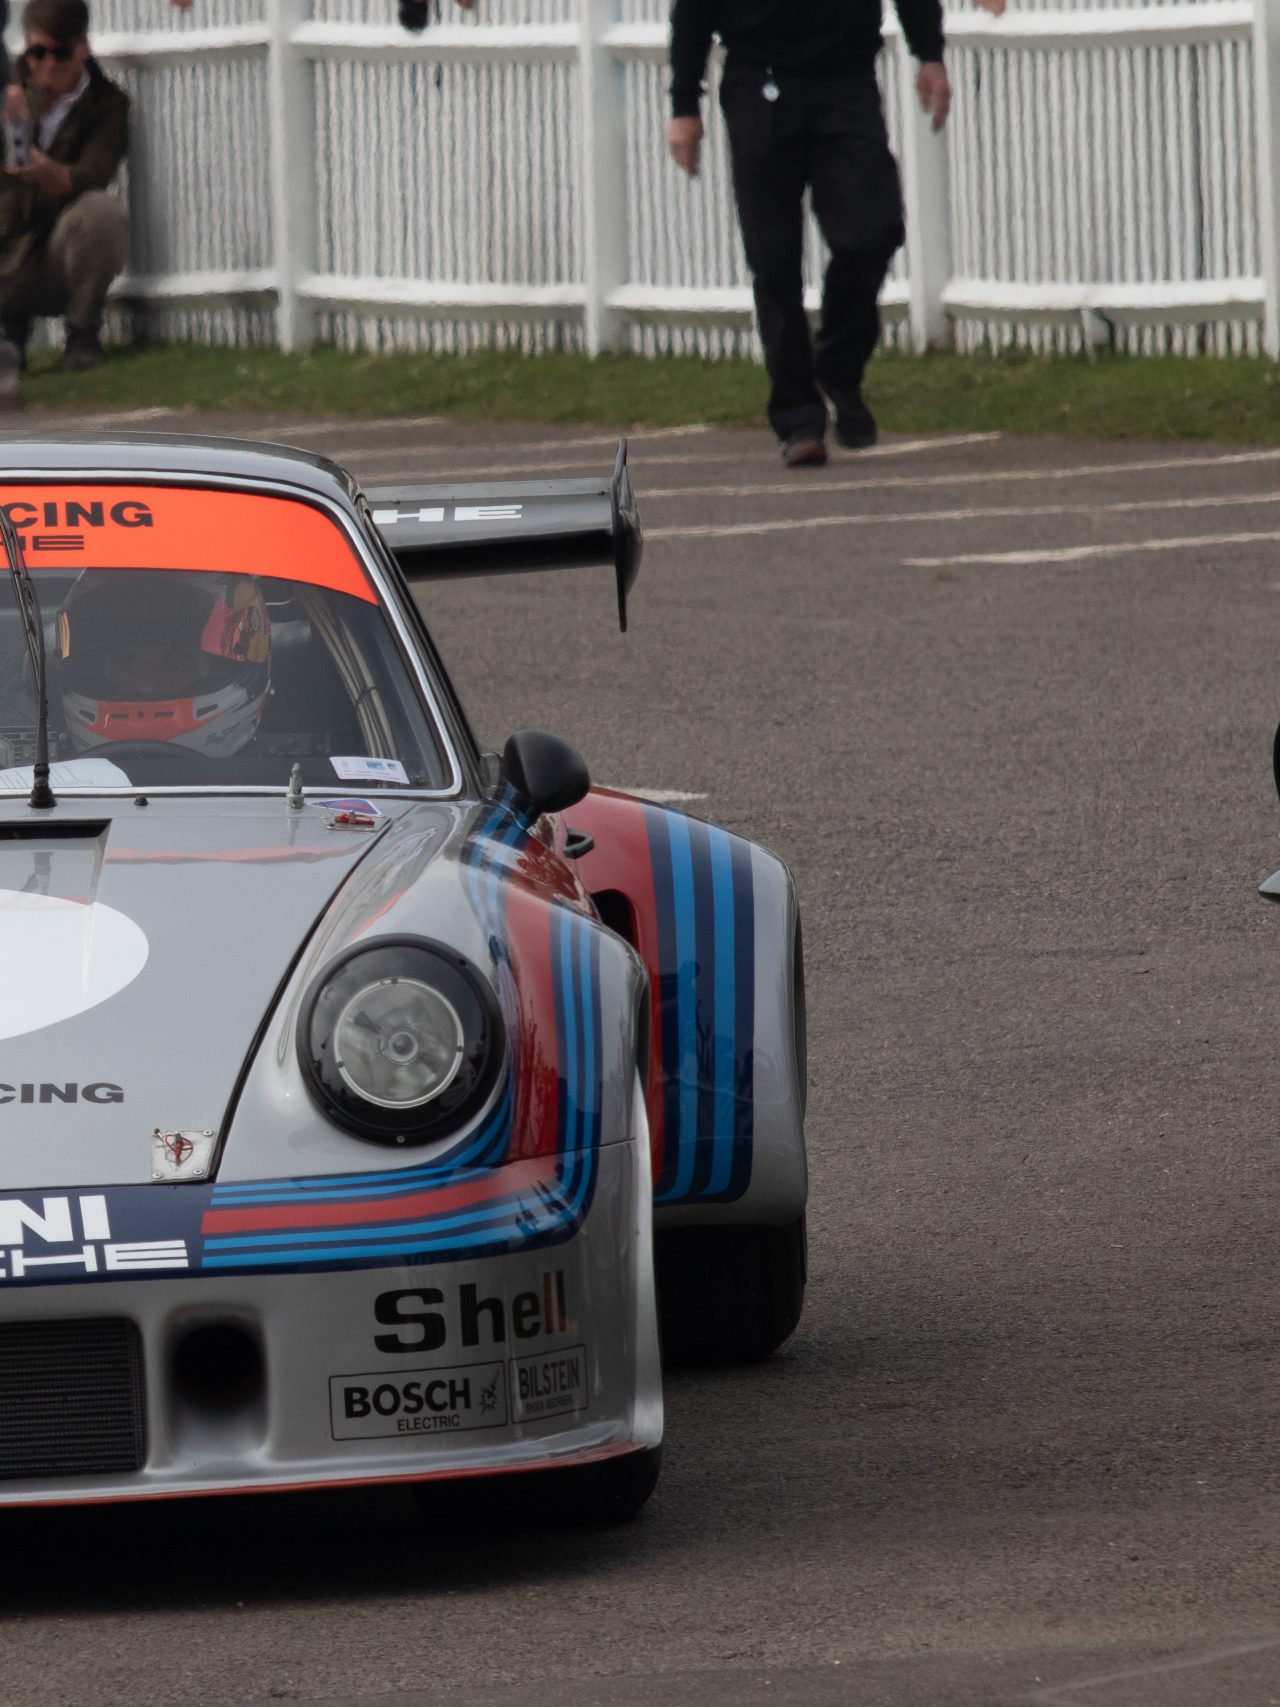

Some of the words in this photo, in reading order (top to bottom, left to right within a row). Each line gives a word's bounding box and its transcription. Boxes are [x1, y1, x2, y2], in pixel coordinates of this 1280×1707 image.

[373, 1270, 568, 1354] Shell
[343, 1378, 472, 1419] BOSCH
[519, 1356, 580, 1400] BILSTEIN
[397, 1414, 460, 1432] ELECTRIC
